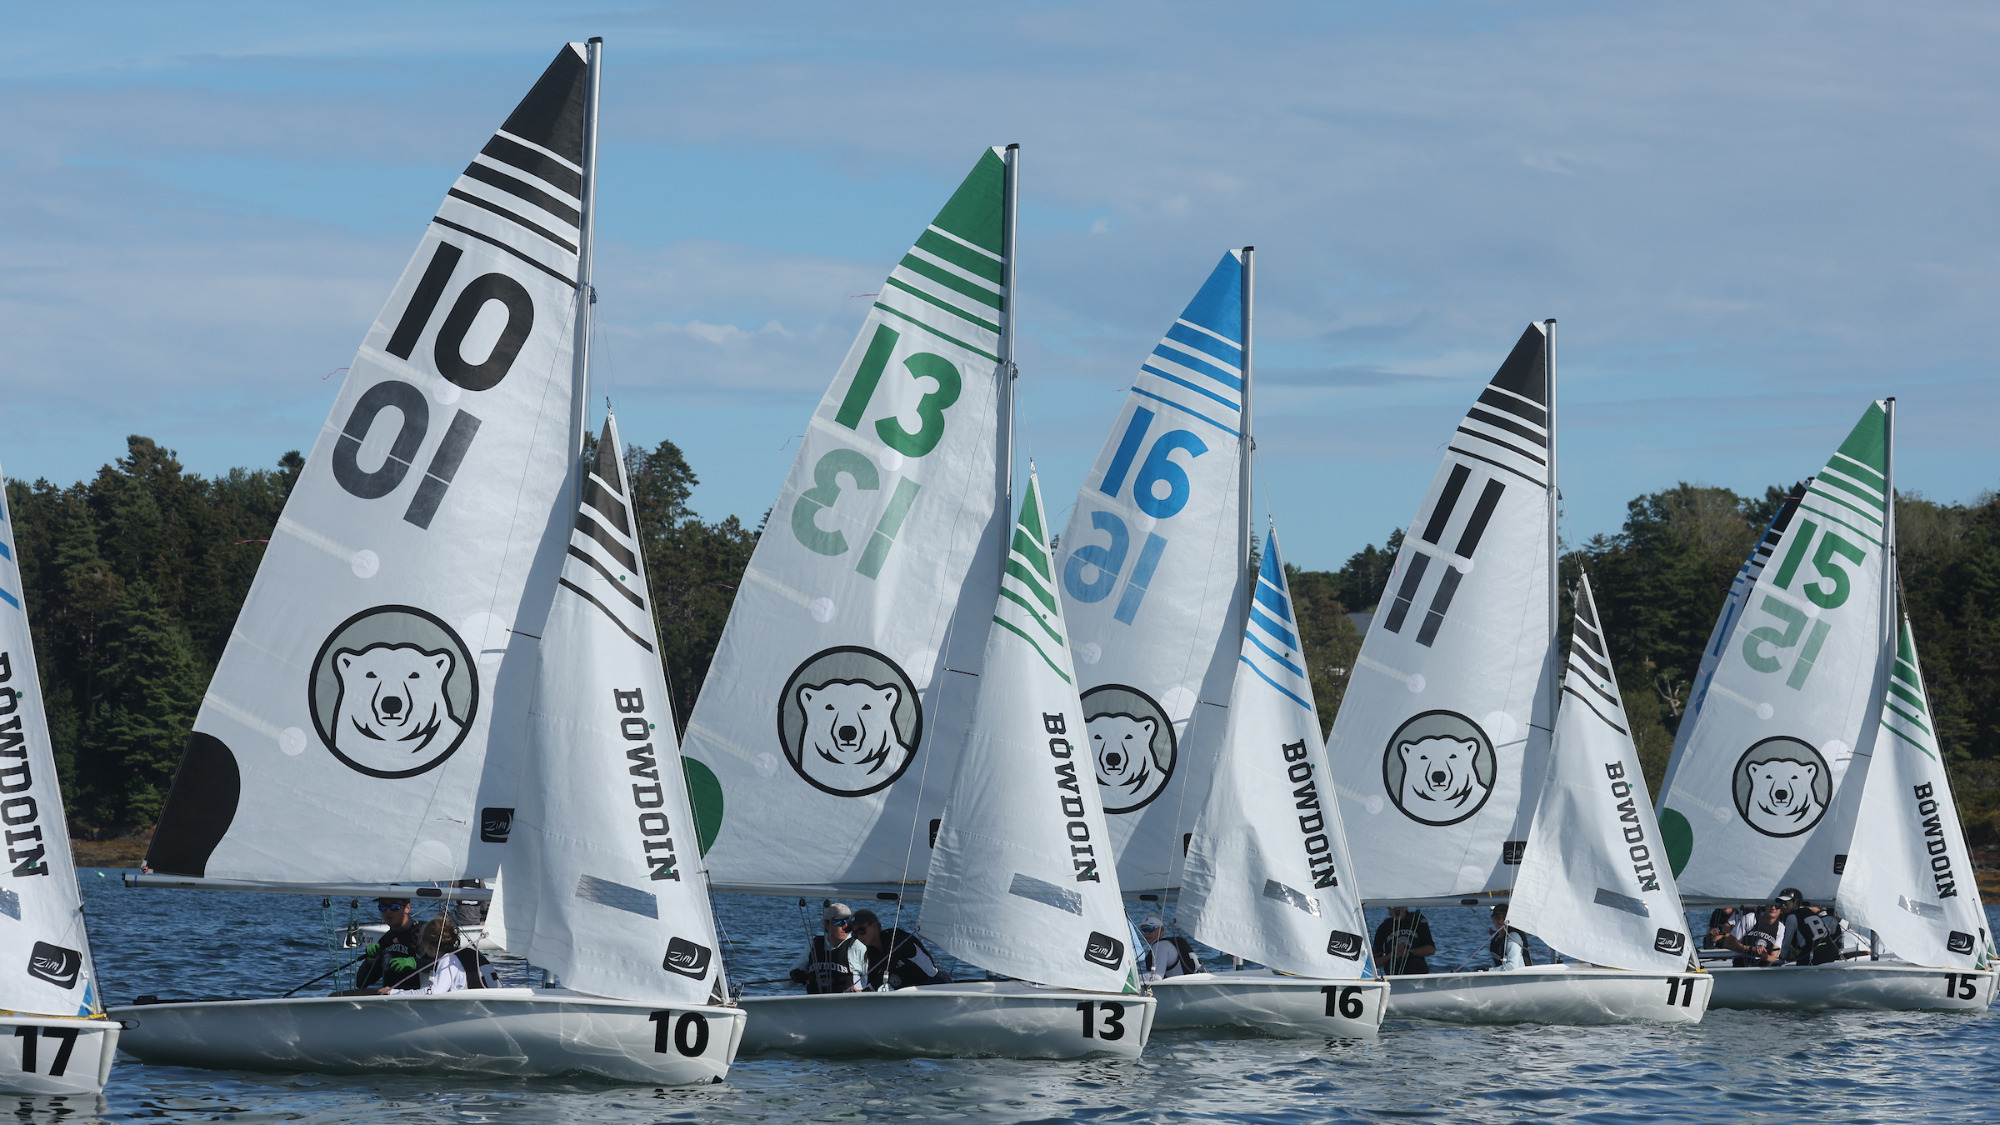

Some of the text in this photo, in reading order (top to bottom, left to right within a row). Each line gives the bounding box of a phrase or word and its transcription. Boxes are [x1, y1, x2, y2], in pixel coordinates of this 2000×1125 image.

[385, 240, 535, 391] 10
[834, 323, 962, 458] 13
[1099, 405, 1209, 519] 16
[1421, 462, 1507, 560] 11
[1772, 518, 1867, 610] 15
[613, 687, 681, 882] BOWDOIN
[1042, 712, 1101, 884] BOWDOIN
[1281, 738, 1339, 890] BOWDOIN
[1604, 760, 1661, 893] BOWDOIN
[1913, 781, 1958, 900] BOWDOIN
[648, 1010, 710, 1058] 10
[1076, 1000, 1125, 1041] 13
[1320, 985, 1364, 1019] 16
[1666, 976, 1696, 1008] 11
[1944, 972, 1978, 1001] 15
[14, 1026, 80, 1077] 17
